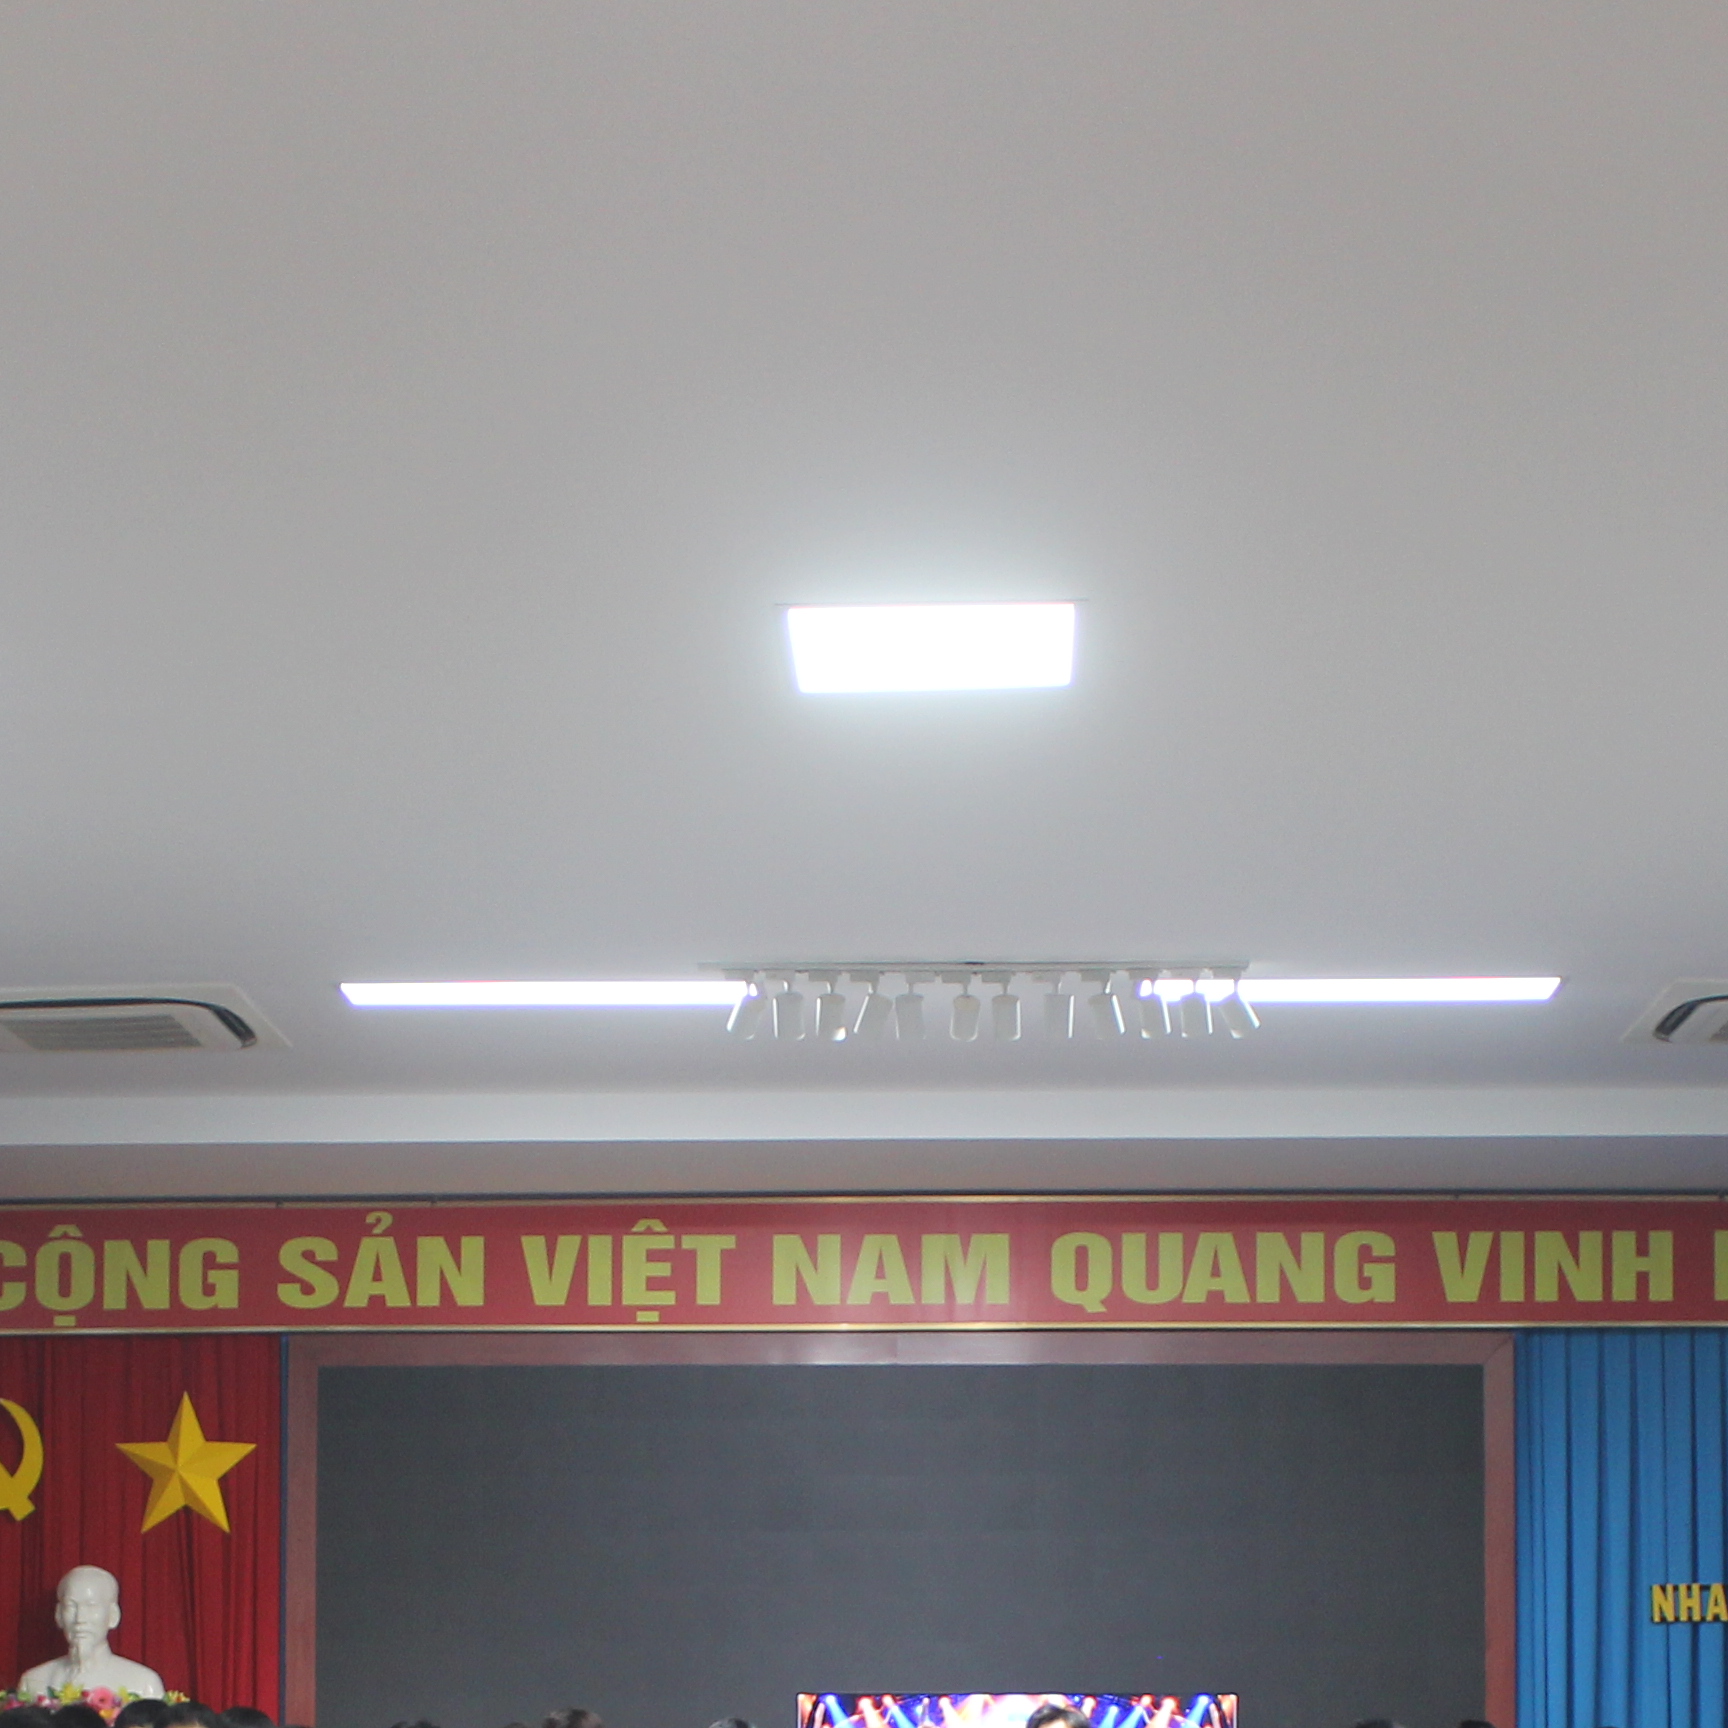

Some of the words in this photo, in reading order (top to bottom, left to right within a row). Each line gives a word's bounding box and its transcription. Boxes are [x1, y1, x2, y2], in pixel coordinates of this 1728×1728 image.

[277, 1211, 486, 1310] SẢN
[520, 1219, 738, 1322] VIỆT
[773, 1234, 1013, 1308] NAM
[1049, 1231, 1398, 1312] QUANG
[1431, 1230, 1674, 1304] VINH
[1650, 1582, 1728, 1622] NHA
